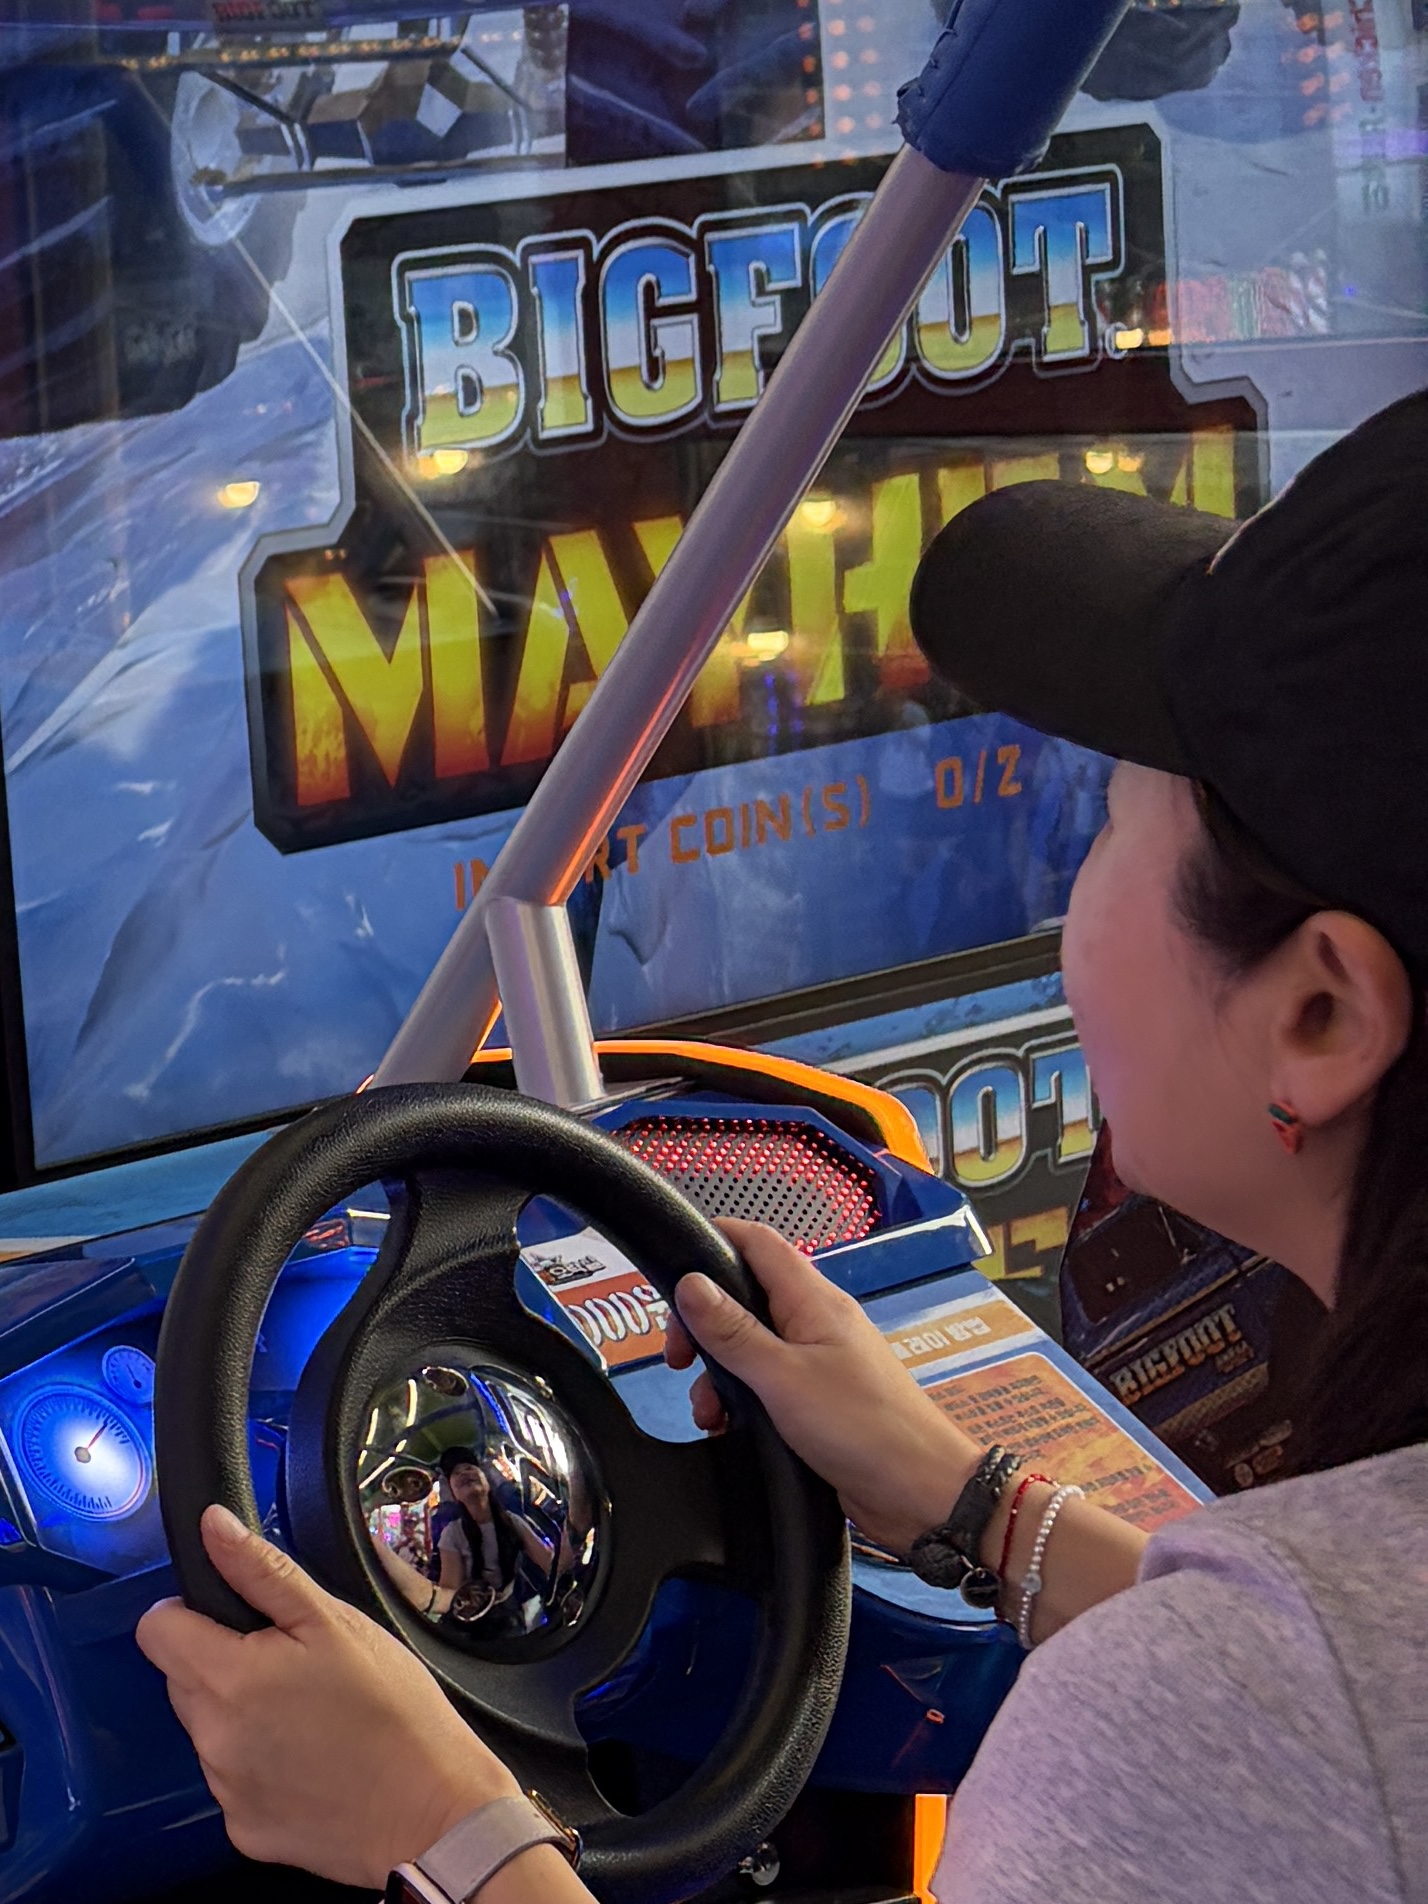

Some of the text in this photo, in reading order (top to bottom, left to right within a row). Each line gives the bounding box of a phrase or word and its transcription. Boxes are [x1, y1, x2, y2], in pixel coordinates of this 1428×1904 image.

[396, 170, 1124, 452] BIGFOT
[669, 774, 872, 865] COIN(S)
[1108, 1302, 1243, 1408] BIGFOOT
